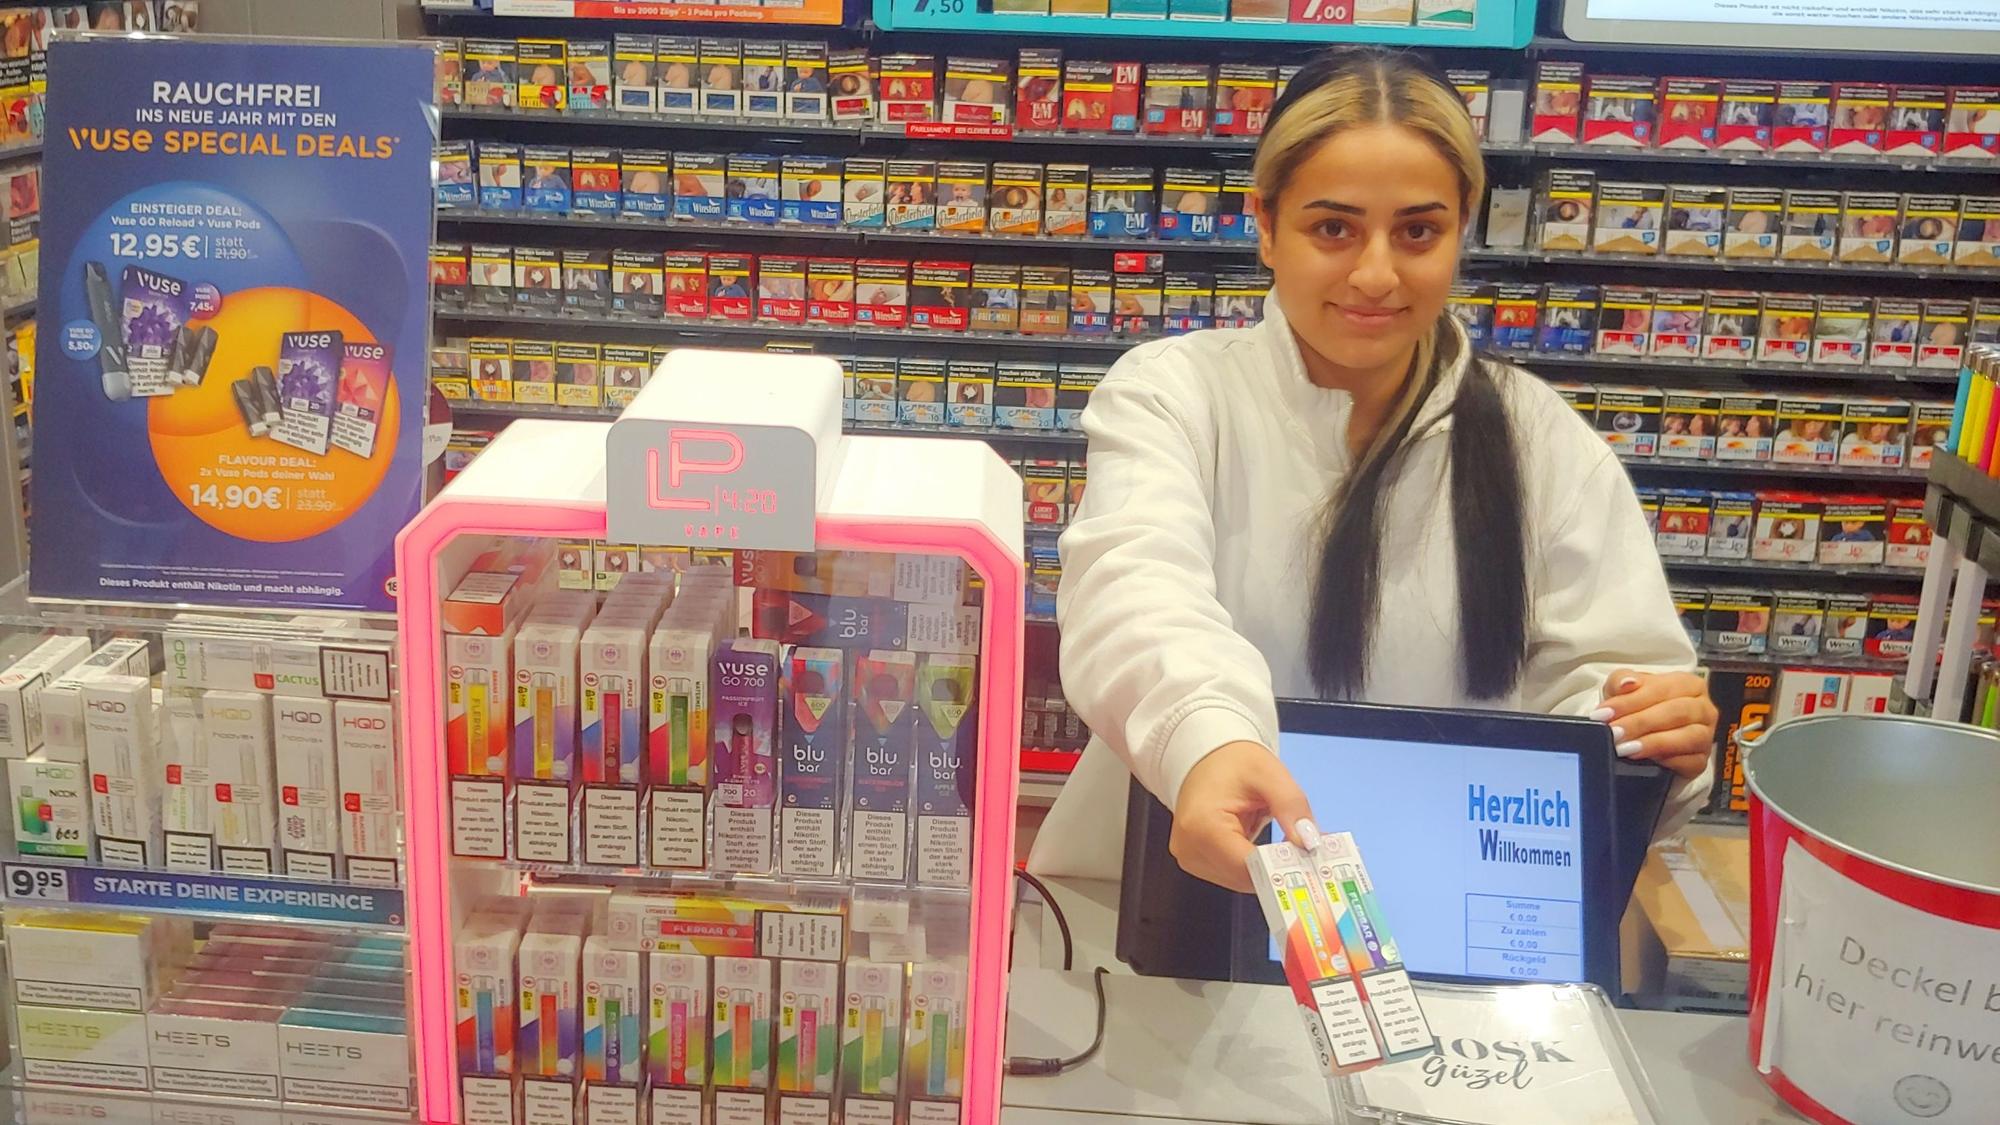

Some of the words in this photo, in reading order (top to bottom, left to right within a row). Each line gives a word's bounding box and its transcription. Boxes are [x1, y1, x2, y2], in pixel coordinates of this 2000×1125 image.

[638, 7, 659, 16] 2000
[152, 80, 320, 107] RAUCHFREI
[136, 108, 164, 123] INS
[169, 110, 213, 124] NEUE
[218, 111, 262, 126] JAHR
[268, 112, 296, 126] MIT
[302, 113, 336, 127] DEN
[164, 129, 287, 156] SPECIAL
[131, 203, 202, 216] EINSTEIGER
[111, 215, 137, 226] Vuse
[139, 216, 156, 226] GO
[158, 216, 195, 228] Reload
[207, 218, 232, 229] Vuse
[235, 219, 260, 230] Pods
[215, 237, 243, 248] statt
[218, 454, 276, 466] FLAVOUR
[215, 468, 240, 477] Vuse
[243, 468, 269, 479] Pods
[271, 469, 305, 480] deiner
[308, 471, 335, 481] Wahl
[189, 484, 282, 510] 14,90€
[683, 523, 740, 540] VAPE
[100, 577, 131, 587] Dieses
[132, 578, 169, 589] Produkt
[171, 580, 205, 590] enthält
[207, 581, 242, 592] Nikotin
[243, 583, 262, 593] und
[264, 583, 294, 594] macht
[296, 584, 344, 597] abhängig.
[839, 608, 857, 639] blu
[1722, 634, 1748, 643] West
[1780, 637, 1807, 647] West
[1829, 639, 1856, 648] West
[275, 673, 319, 686] CACTUS
[721, 676, 740, 686] GO
[743, 677, 765, 687] 700
[1745, 676, 1771, 687] 200
[87, 700, 127, 713] HQD
[210, 709, 251, 720] HQD
[281, 710, 323, 723] HQD
[343, 717, 386, 730] HQD
[793, 744, 825, 761] blu
[866, 747, 898, 764] blu
[929, 752, 960, 768] blu
[35, 767, 74, 779] HQD
[798, 762, 820, 773] bar
[870, 765, 893, 775] bar
[933, 769, 956, 780] bar
[1468, 783, 1570, 827] Herzlich
[1479, 828, 1571, 867] Willkommen
[12, 869, 34, 896] 9
[36, 872, 63, 887] 95
[93, 876, 172, 897] STARTE
[177, 883, 239, 902] DEINE
[243, 886, 374, 911] EXPERIENCE
[1506, 900, 1541, 911] Summe
[1509, 913, 1515, 921] €
[673, 925, 723, 936] FLERBAR
[1501, 926, 1513, 936] Zu
[1515, 927, 1547, 937] zahlen
[1510, 939, 1516, 948] €
[1502, 952, 1547, 965] Rückgeld
[1510, 967, 1516, 975] €
[1839, 936, 1973, 1006] Deckel
[1794, 963, 1865, 1020] hier
[26, 1021, 100, 1039] HEETS
[154, 1030, 231, 1048] HEETS
[286, 1041, 362, 1059] HEETS
[1432, 1034, 1575, 1063] IOSK
[1422, 1052, 1534, 1090] Güzel
